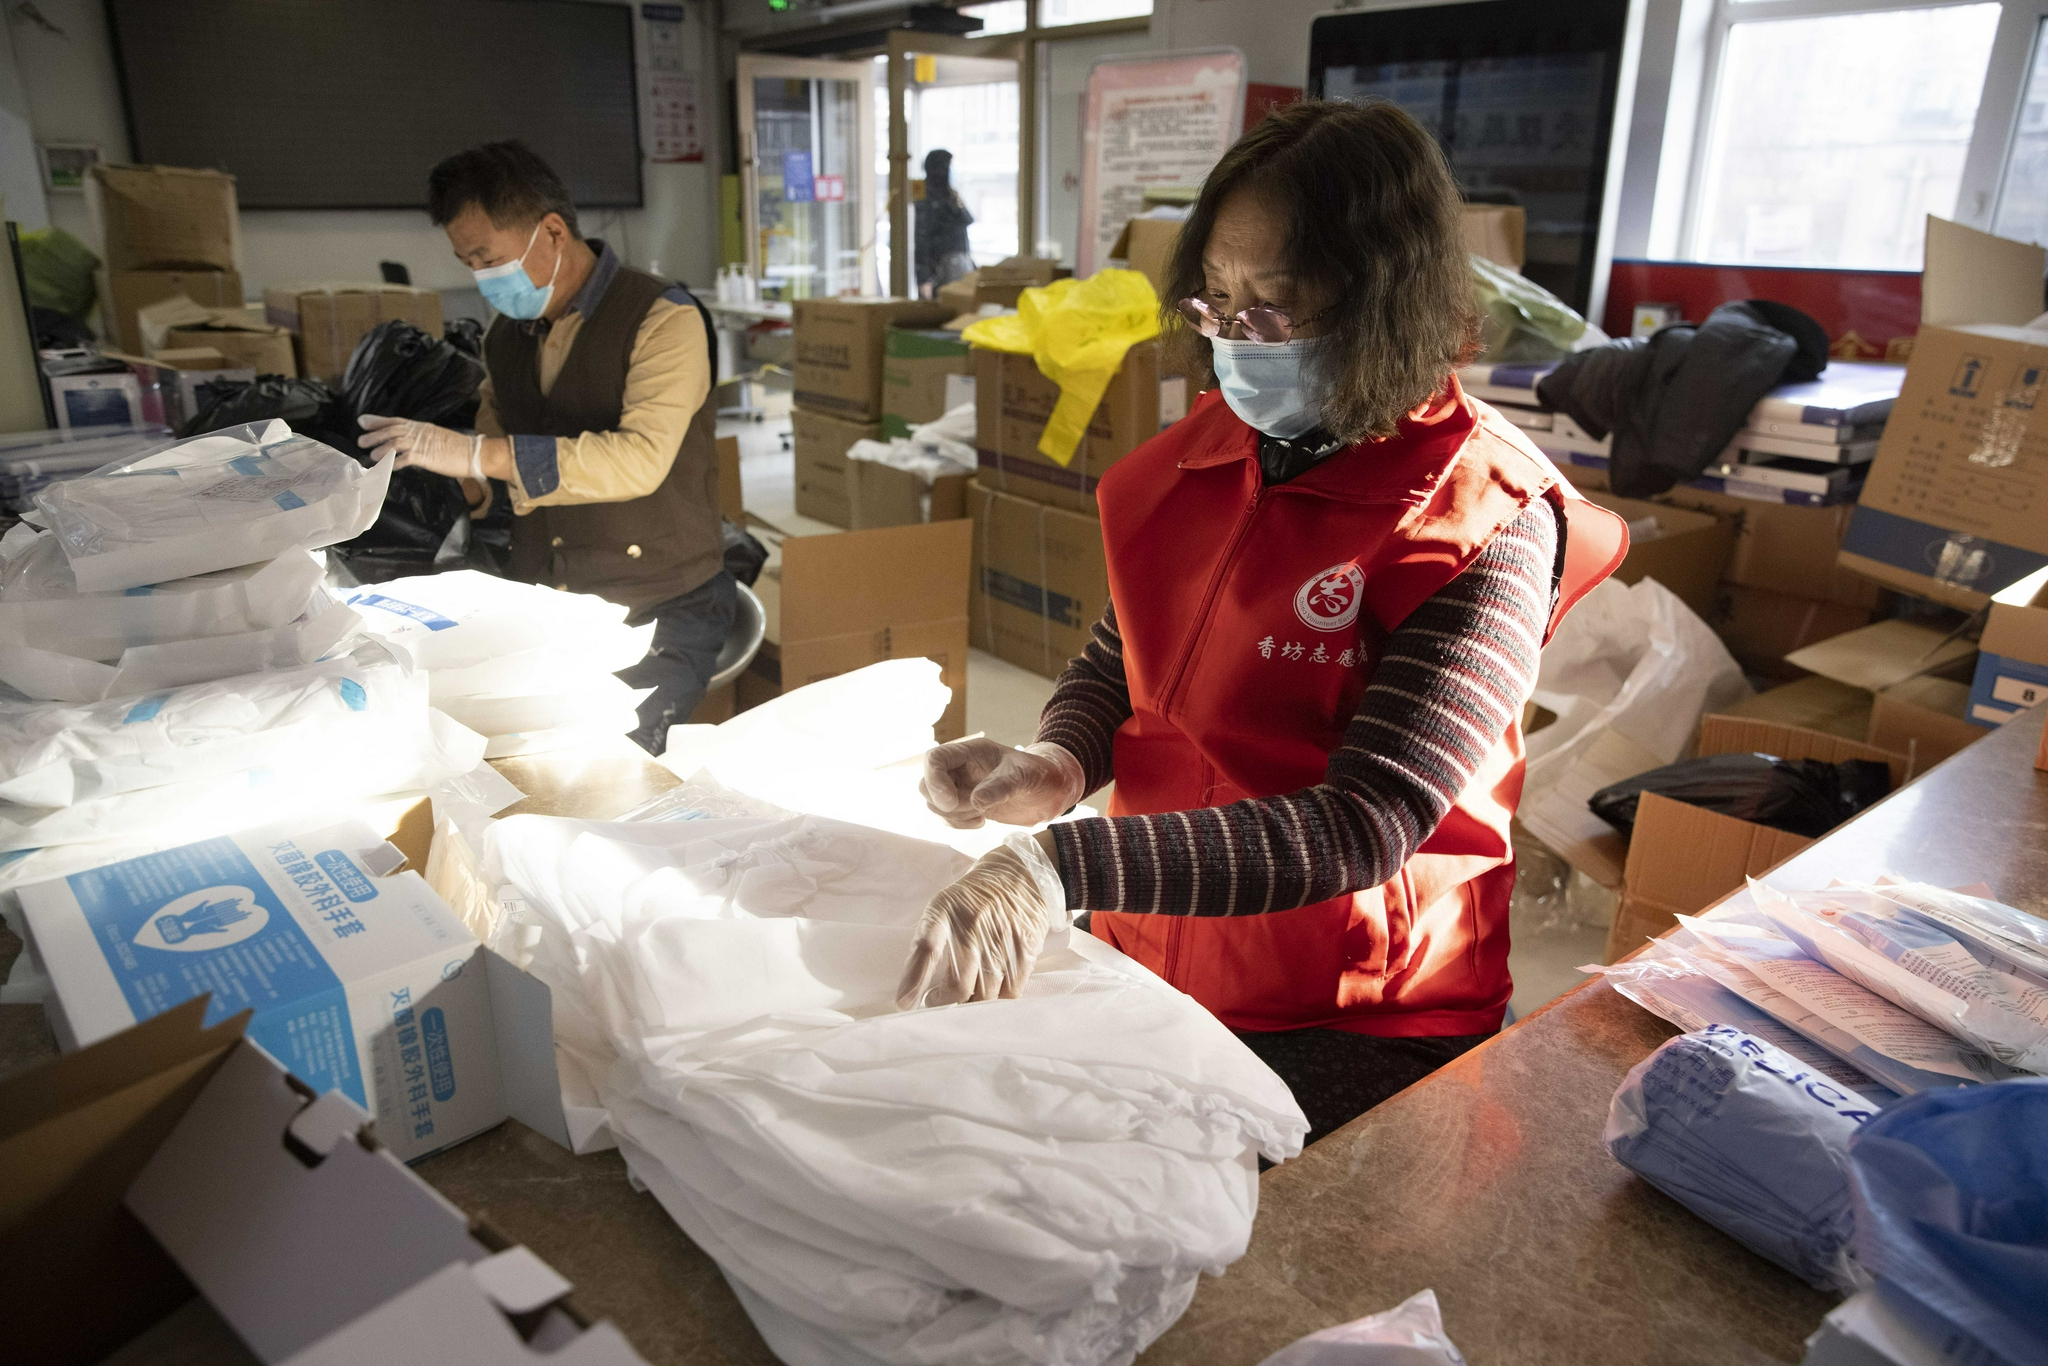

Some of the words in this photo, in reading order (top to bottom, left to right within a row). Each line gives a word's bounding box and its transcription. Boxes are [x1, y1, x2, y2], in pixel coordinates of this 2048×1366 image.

[1298, 596, 1307, 615] China
[1306, 612, 1338, 627] Volunteer
[1338, 605, 1360, 625] Service
[1257, 635, 1369, 668] 香坊志愿者
[267, 840, 368, 939] 灭菌橡胶外科手套
[325, 852, 373, 899] 一次性使用
[390, 986, 435, 1140] 灭菌橡胶外科手套
[427, 1013, 451, 1095] 一次性使用
